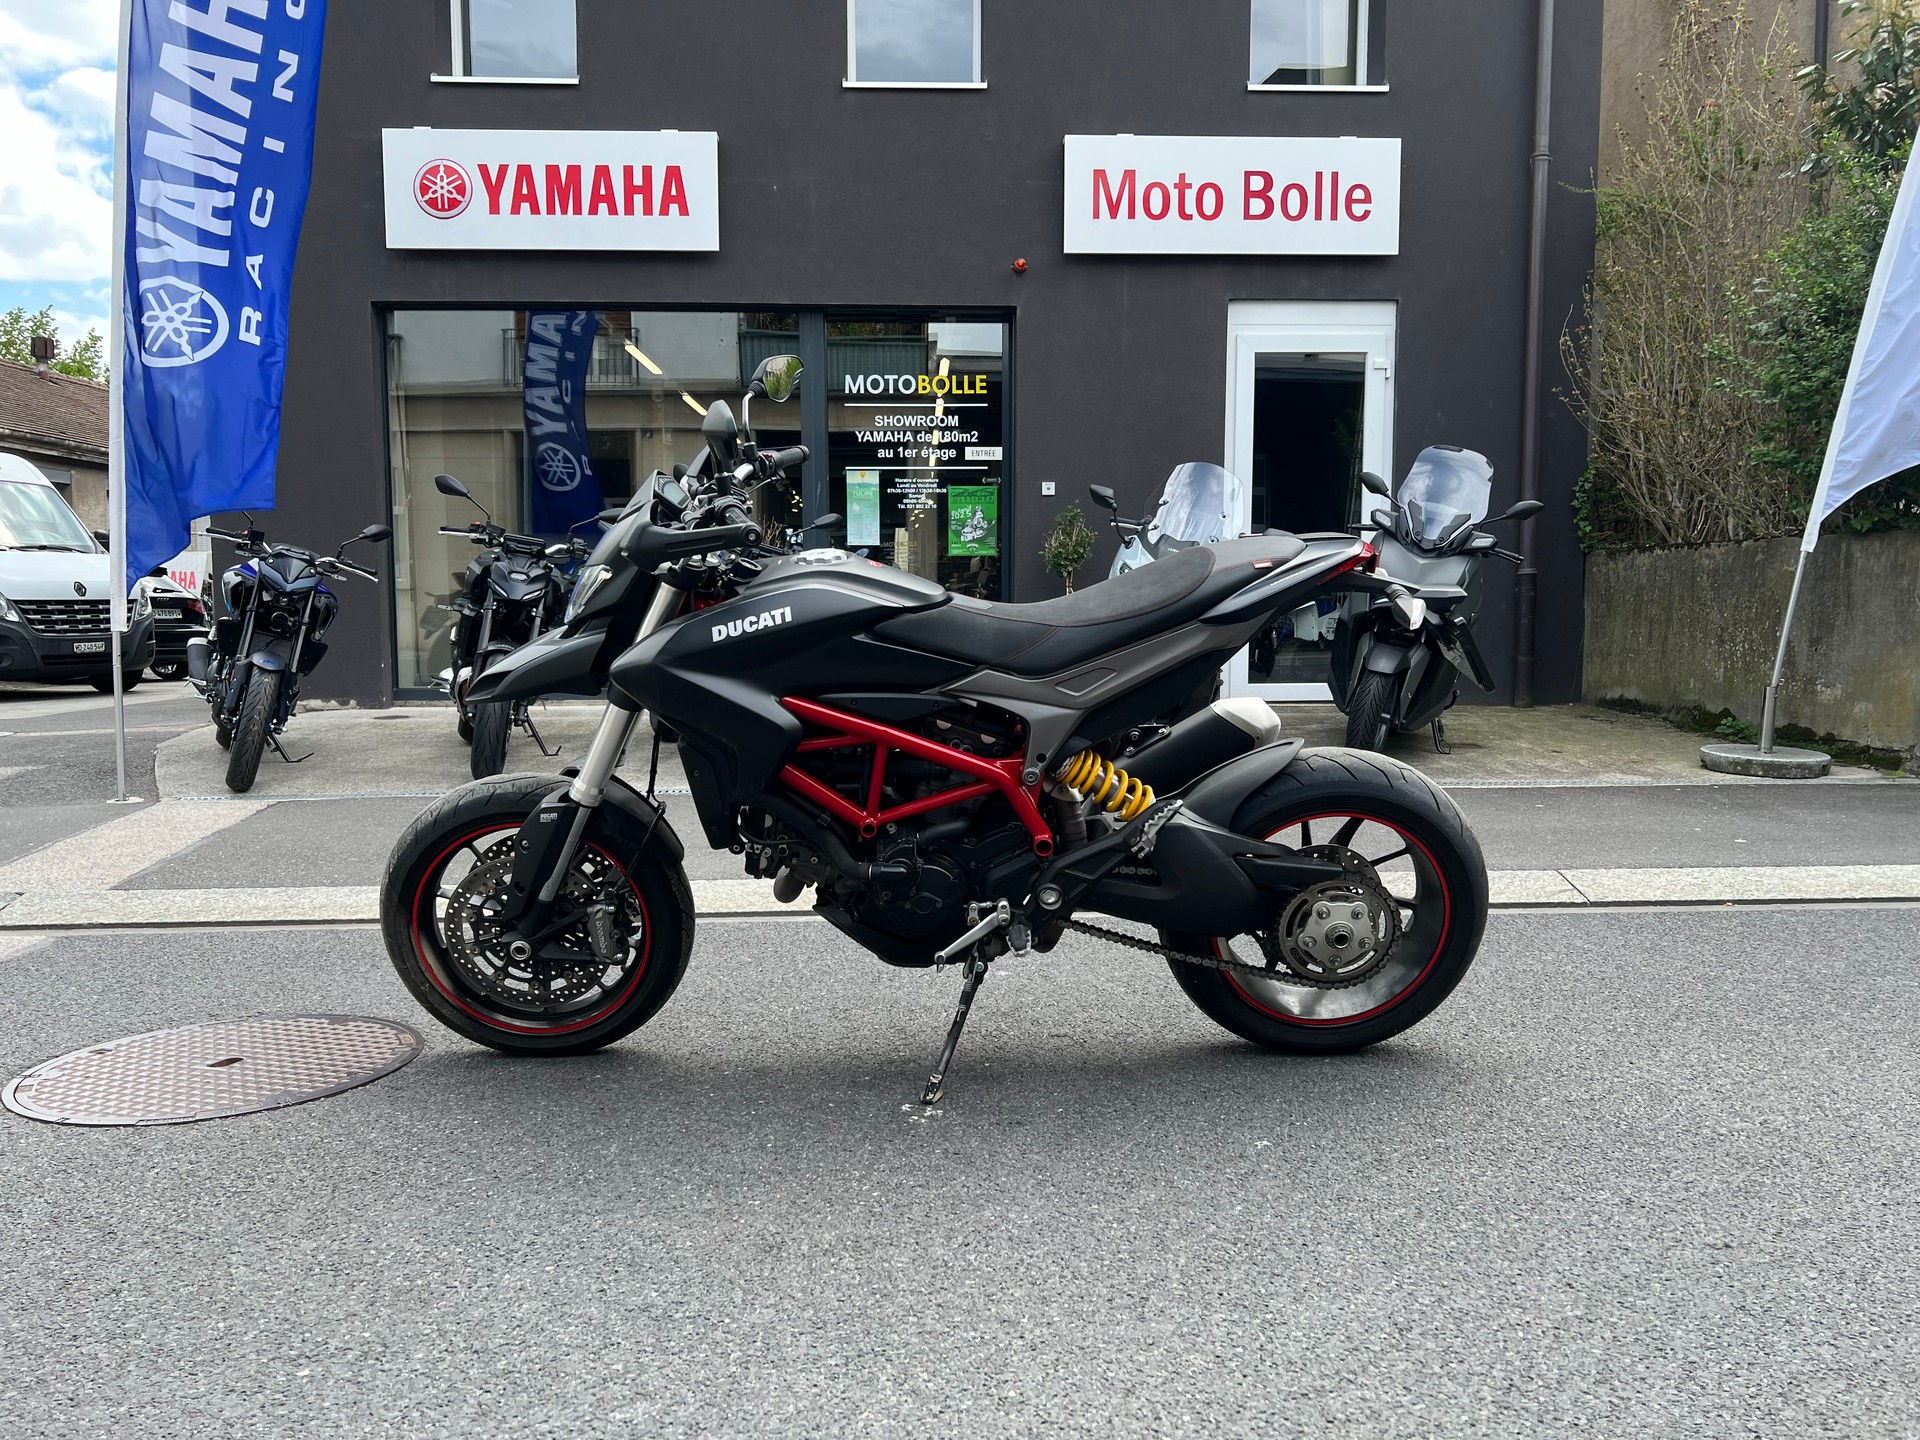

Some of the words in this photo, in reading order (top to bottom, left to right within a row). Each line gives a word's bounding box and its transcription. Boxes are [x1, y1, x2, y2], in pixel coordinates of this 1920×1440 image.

[476, 163, 690, 217] YAMAHA
[1091, 168, 1224, 222] Moto
[1242, 169, 1373, 223] Bolle
[844, 374, 988, 395] MOTOBOLLE
[874, 415, 959, 427] SHOWROOM
[855, 431, 914, 443] YAMAHA
[916, 431, 932, 443] de
[938, 431, 979, 443] 180m2
[877, 448, 894, 458] au
[897, 446, 918, 458] 1er
[921, 446, 957, 460] étage
[971, 448, 996, 457] ENTRÉE
[711, 606, 793, 643] DUCATI
